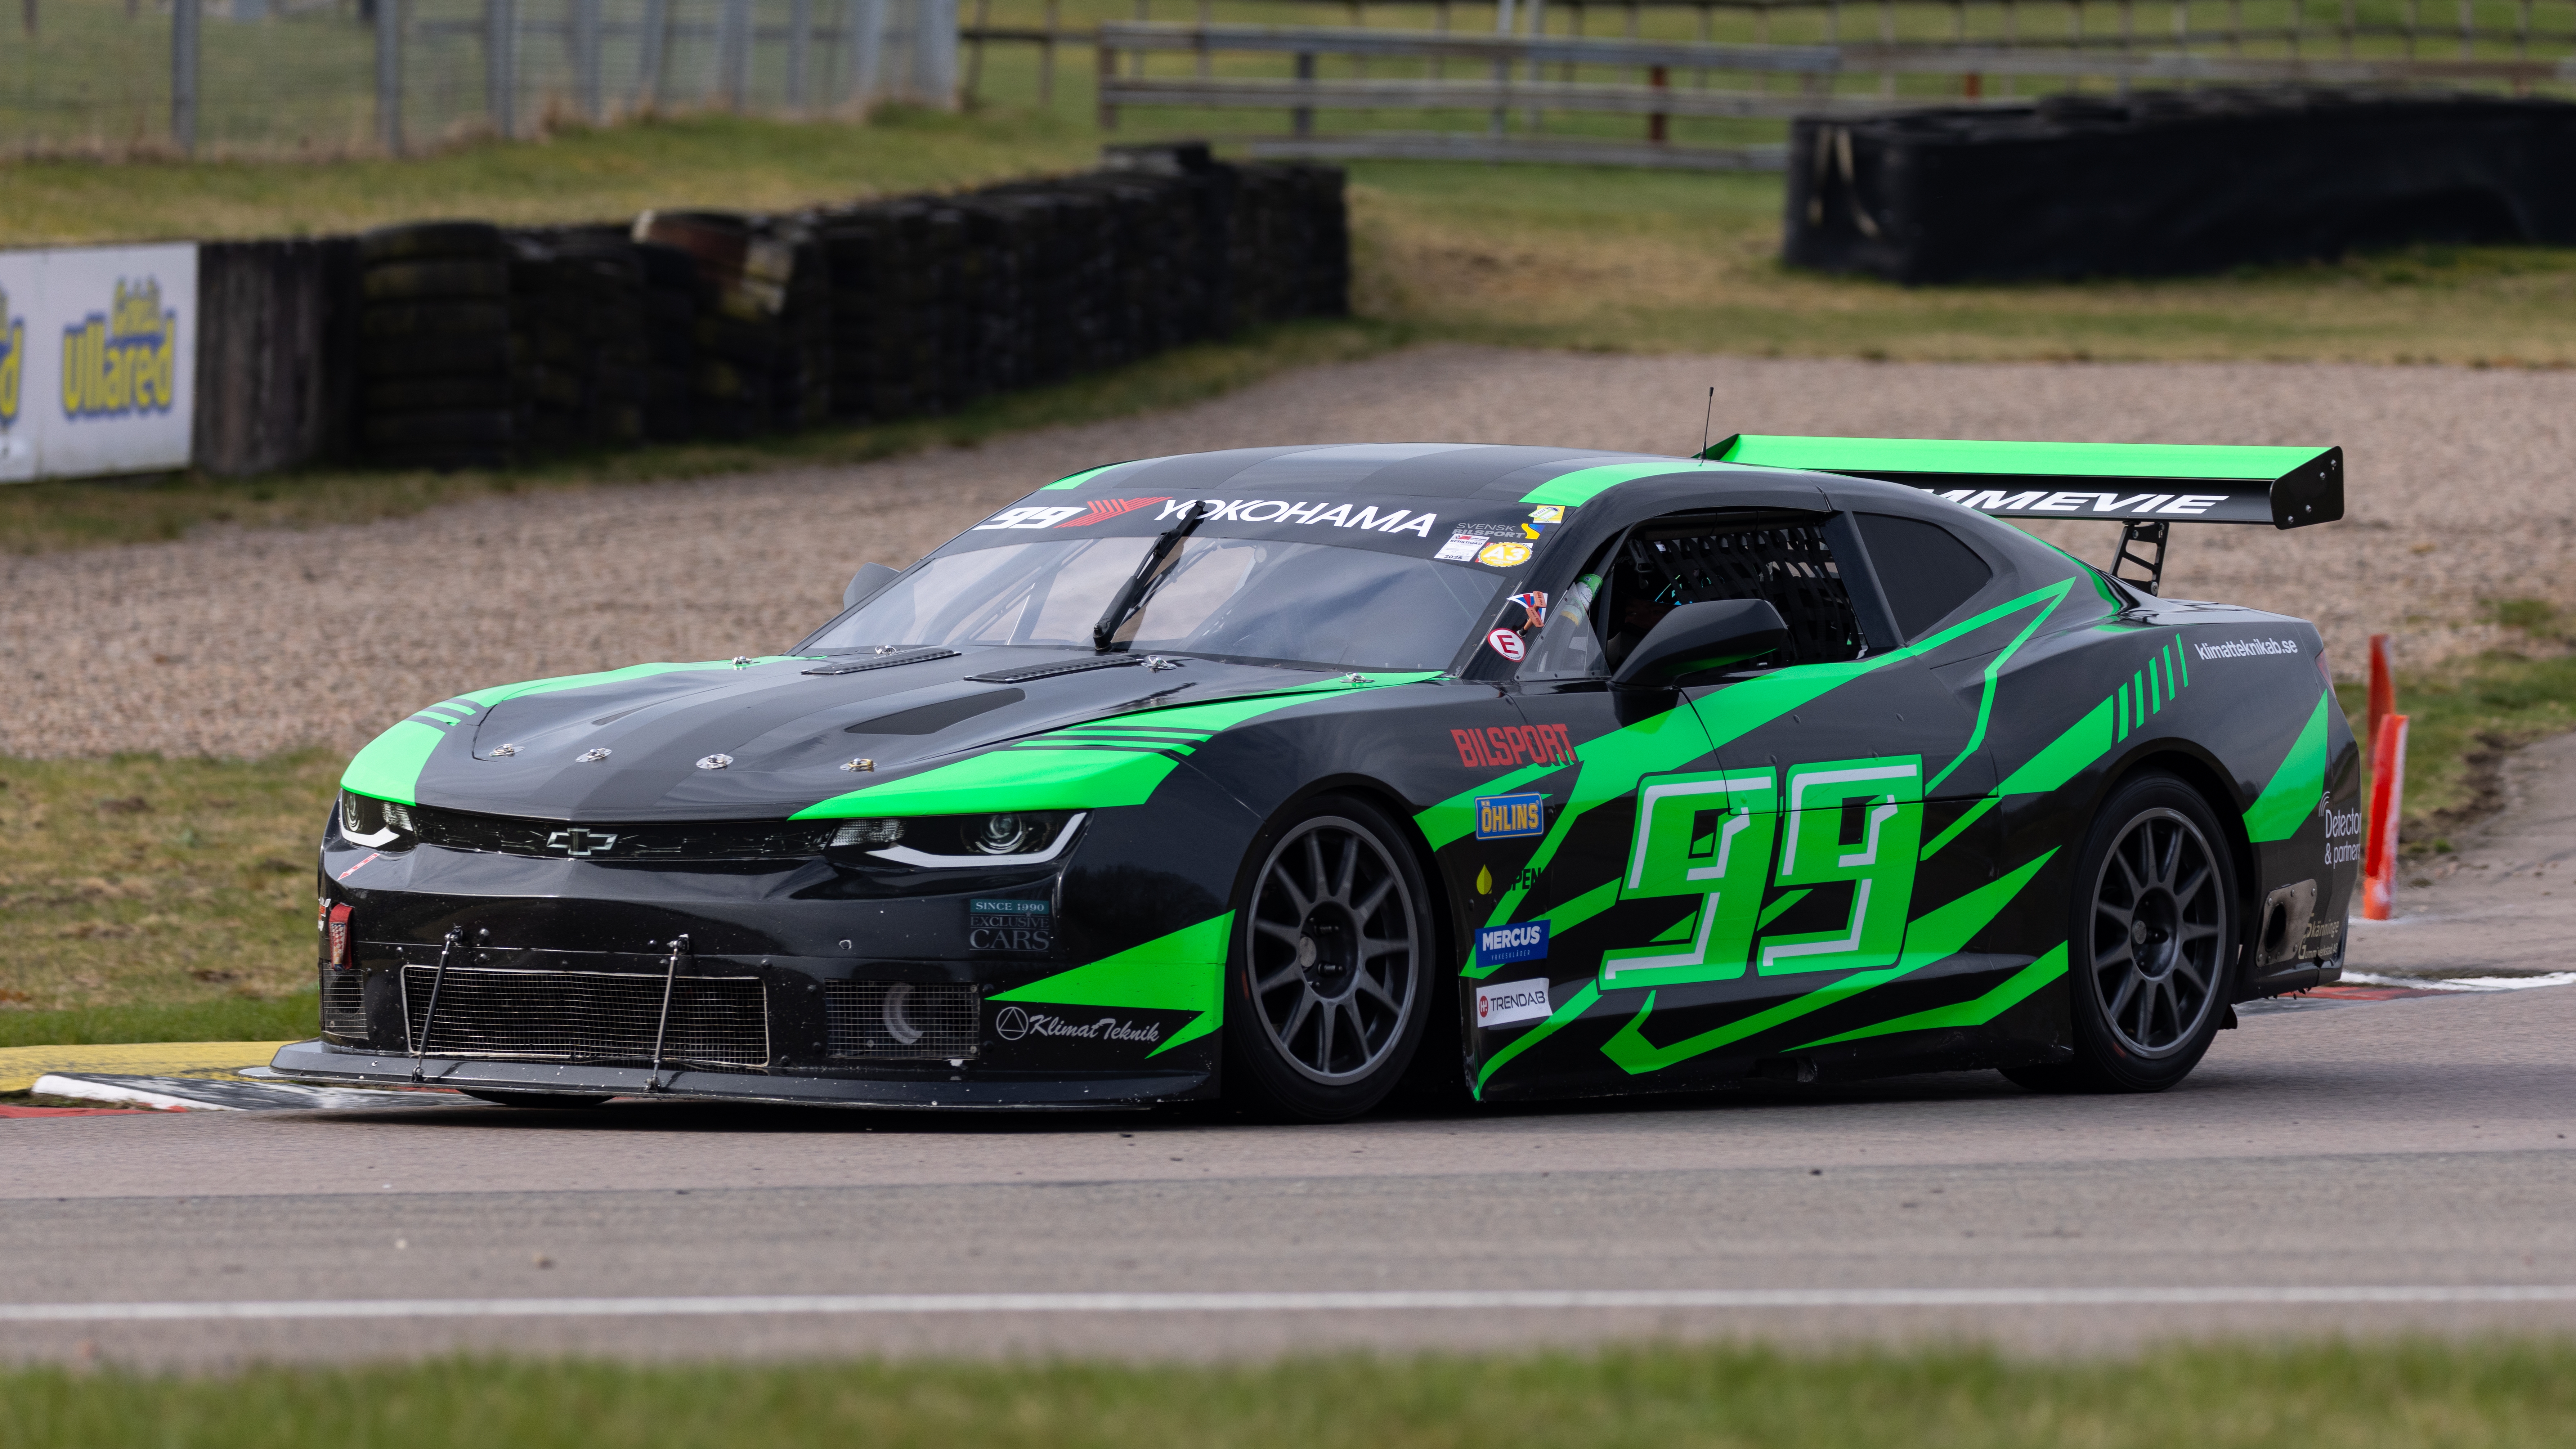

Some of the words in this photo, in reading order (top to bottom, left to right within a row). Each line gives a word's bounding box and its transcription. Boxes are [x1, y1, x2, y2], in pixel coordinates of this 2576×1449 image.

[972, 506, 1087, 530] 99
[1154, 499, 1437, 538] YOKOHAMA
[1456, 523, 1516, 531] SVENSK
[1452, 529, 1526, 538] BILSPORT
[1483, 546, 1526, 561] A3
[1496, 635, 1519, 655] E
[2194, 638, 2298, 660] klimatteknikab.se
[1450, 723, 1576, 767] BILSPORT
[1481, 800, 1539, 833] ÖHLINS
[2325, 842, 2332, 865] &
[1598, 754, 1924, 991] 99
[976, 902, 1012, 910] SINCE
[1017, 903, 1044, 911] 1990
[970, 916, 1049, 928] EXCLUSIVE
[970, 929, 1049, 950] CARS
[1483, 926, 1541, 951] MERCUS
[1491, 950, 1530, 961] YRKESKLÄDER
[1490, 991, 1546, 1011] TRENDAB
